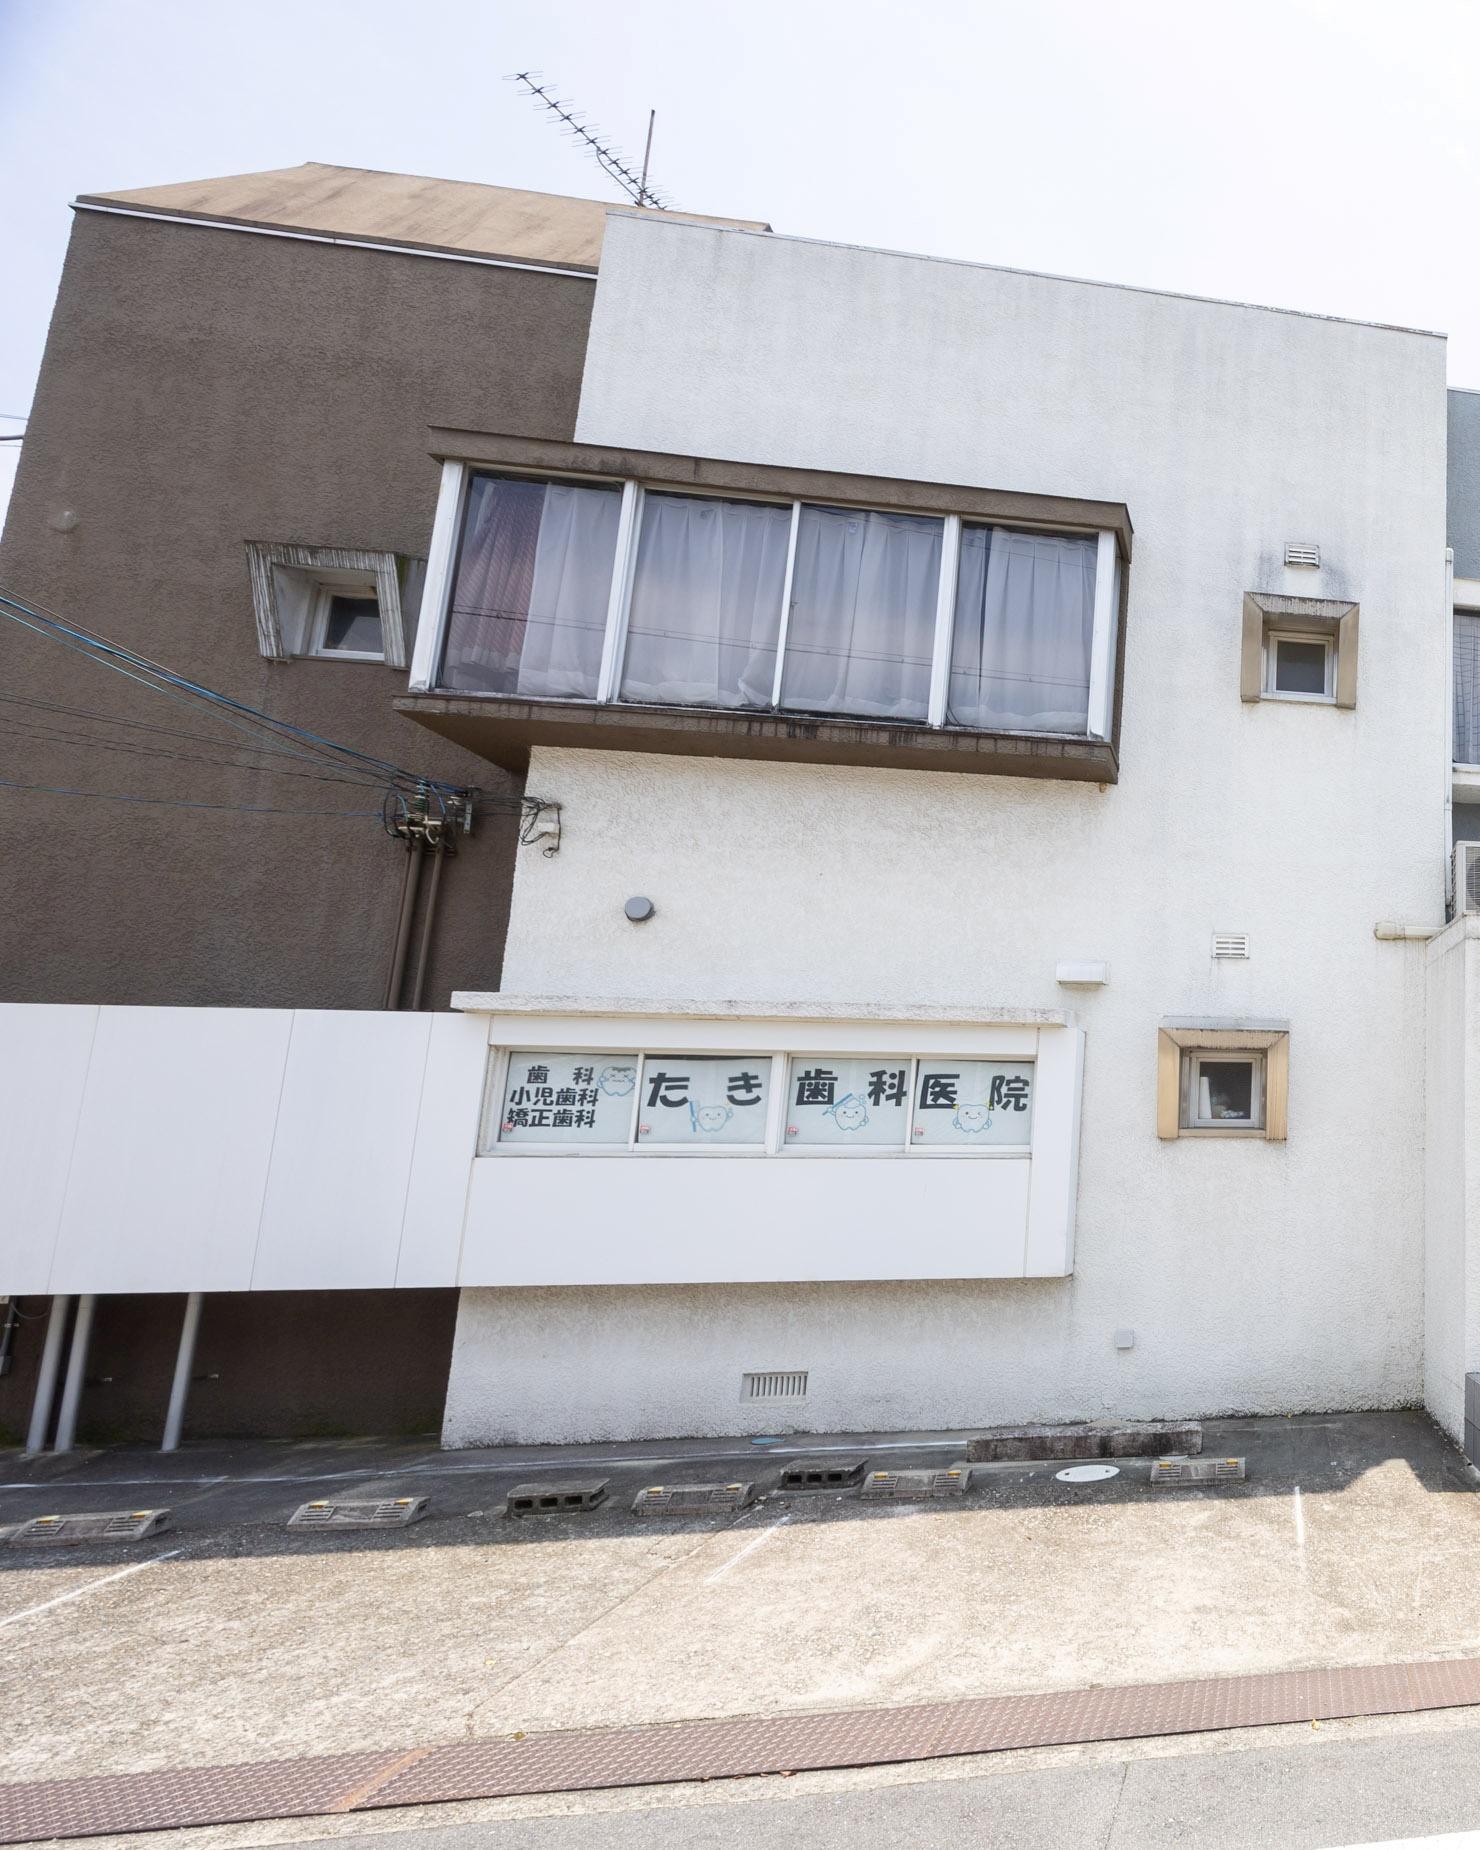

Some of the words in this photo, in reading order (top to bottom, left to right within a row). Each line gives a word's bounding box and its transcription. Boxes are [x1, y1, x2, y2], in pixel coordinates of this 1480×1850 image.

[526, 1065, 595, 1086] 歯科
[509, 1086, 600, 1107] 小児歯科
[646, 1068, 1031, 1113] たき歯科医院
[506, 1107, 597, 1129] 矯正歯科
